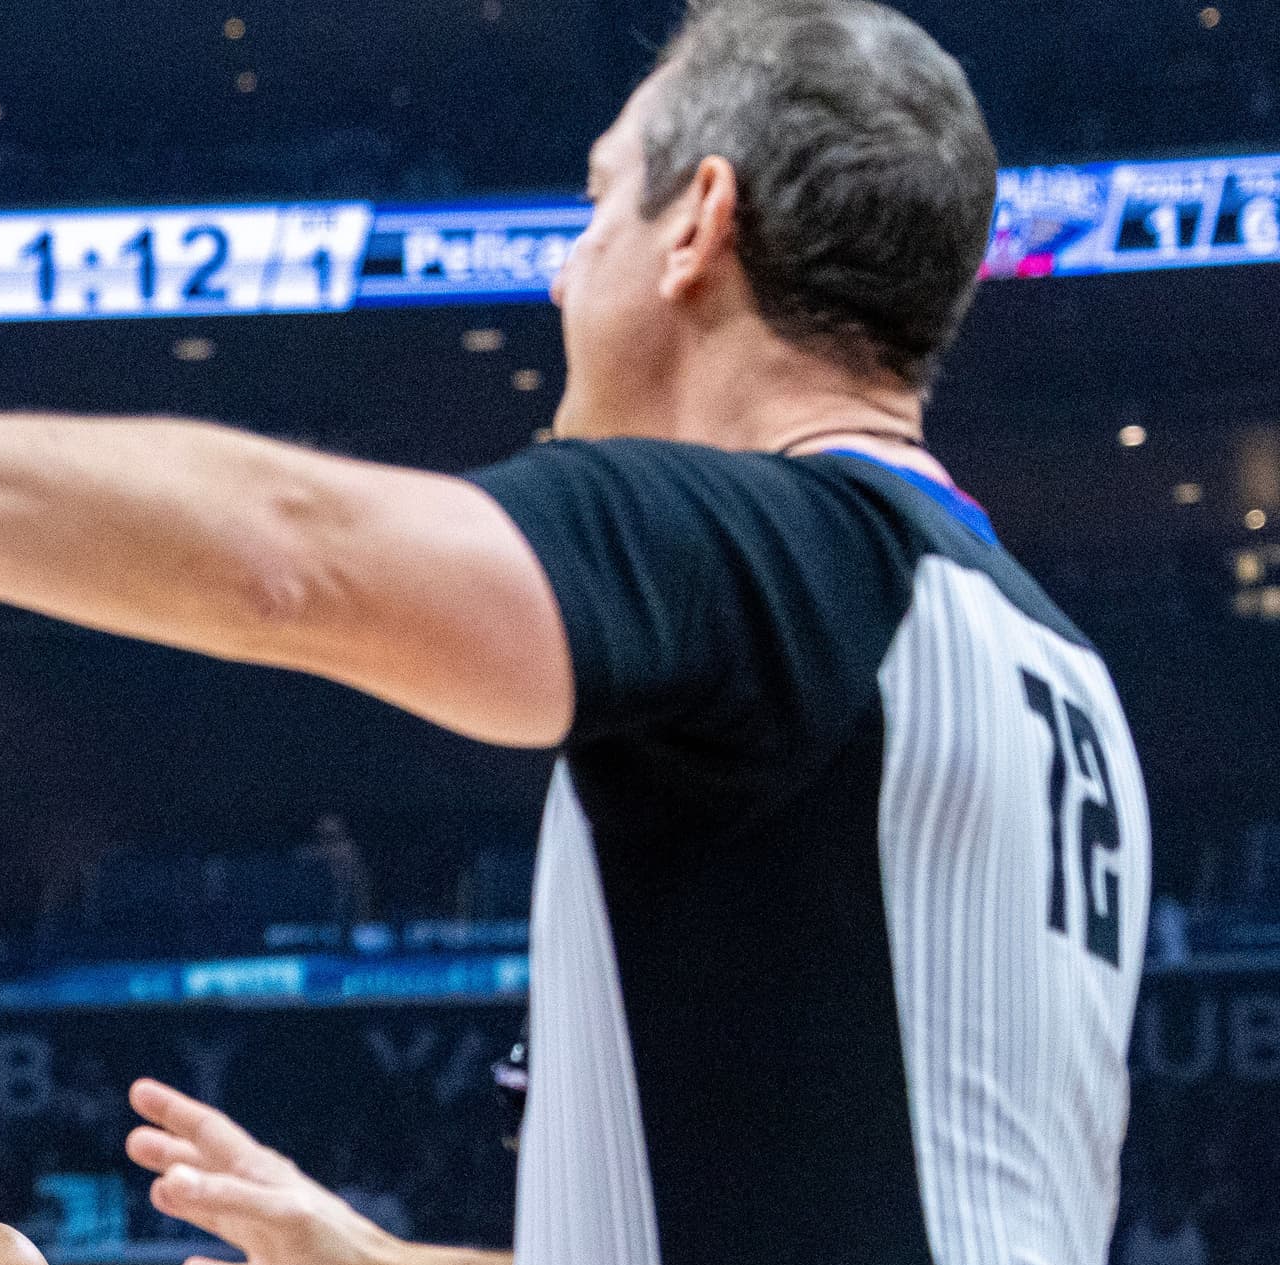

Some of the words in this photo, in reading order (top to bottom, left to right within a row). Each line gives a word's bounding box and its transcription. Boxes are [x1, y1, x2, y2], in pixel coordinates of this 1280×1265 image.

[18, 224, 230, 302] 1:12
[311, 250, 336, 296] 1
[1018, 663, 1122, 970] 12
